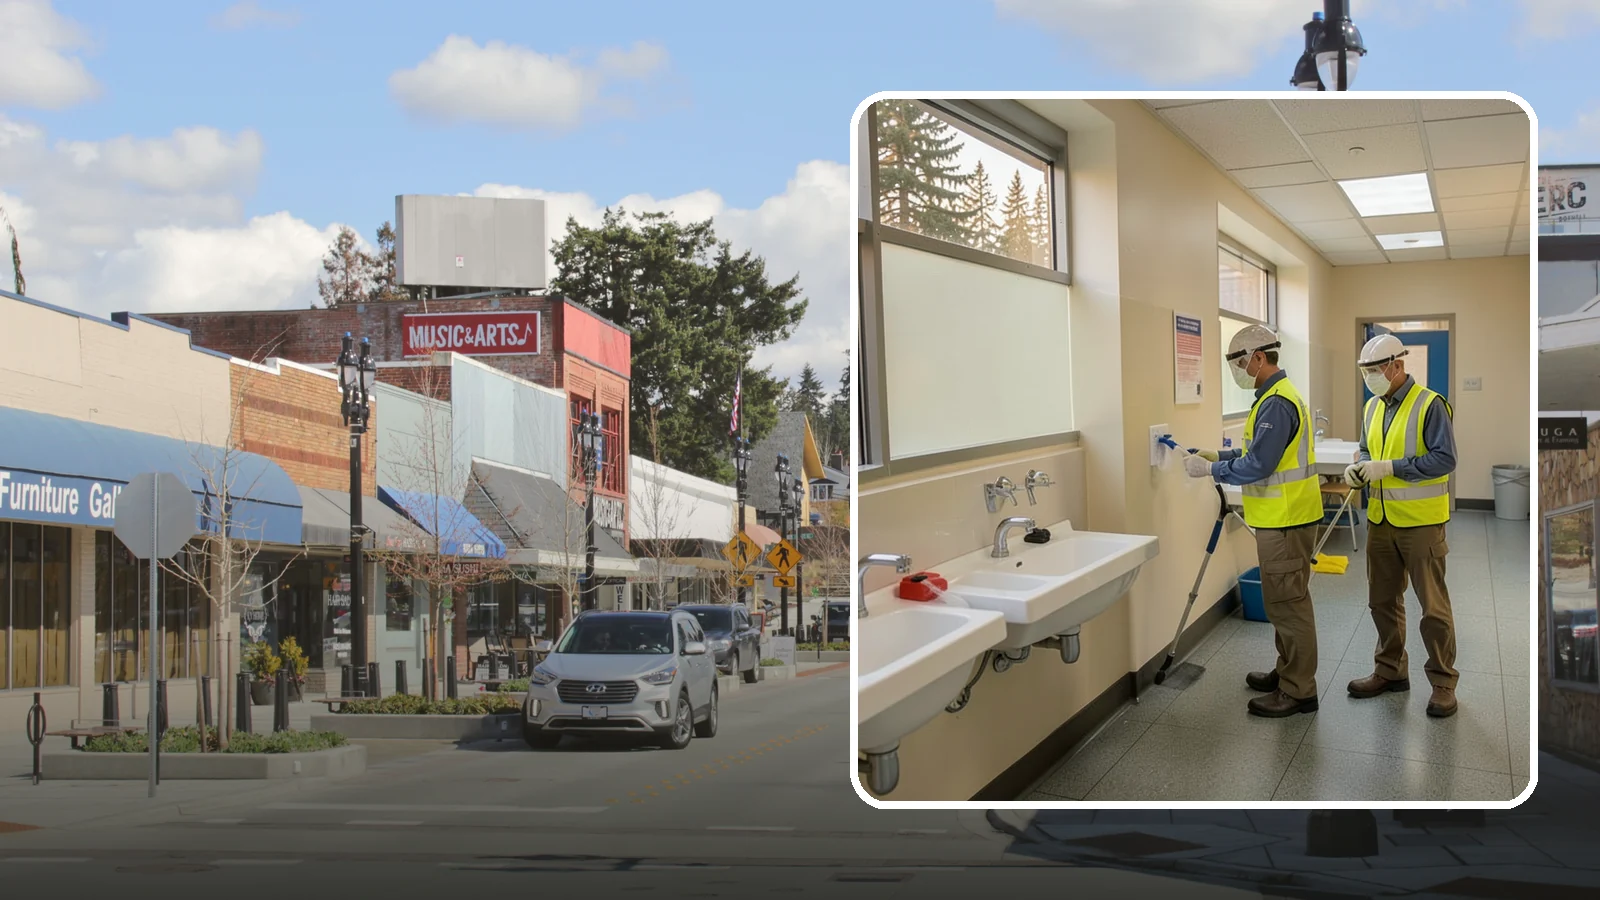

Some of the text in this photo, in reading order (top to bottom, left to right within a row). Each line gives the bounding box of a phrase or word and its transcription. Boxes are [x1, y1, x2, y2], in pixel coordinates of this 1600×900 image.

[408, 323, 520, 349] MUSIC&ARTS
[1540, 427, 1577, 436] UGA
[0, 471, 79, 515] Furniture
[453, 563, 479, 574] SUSHI
[327, 594, 341, 606] HAIR
